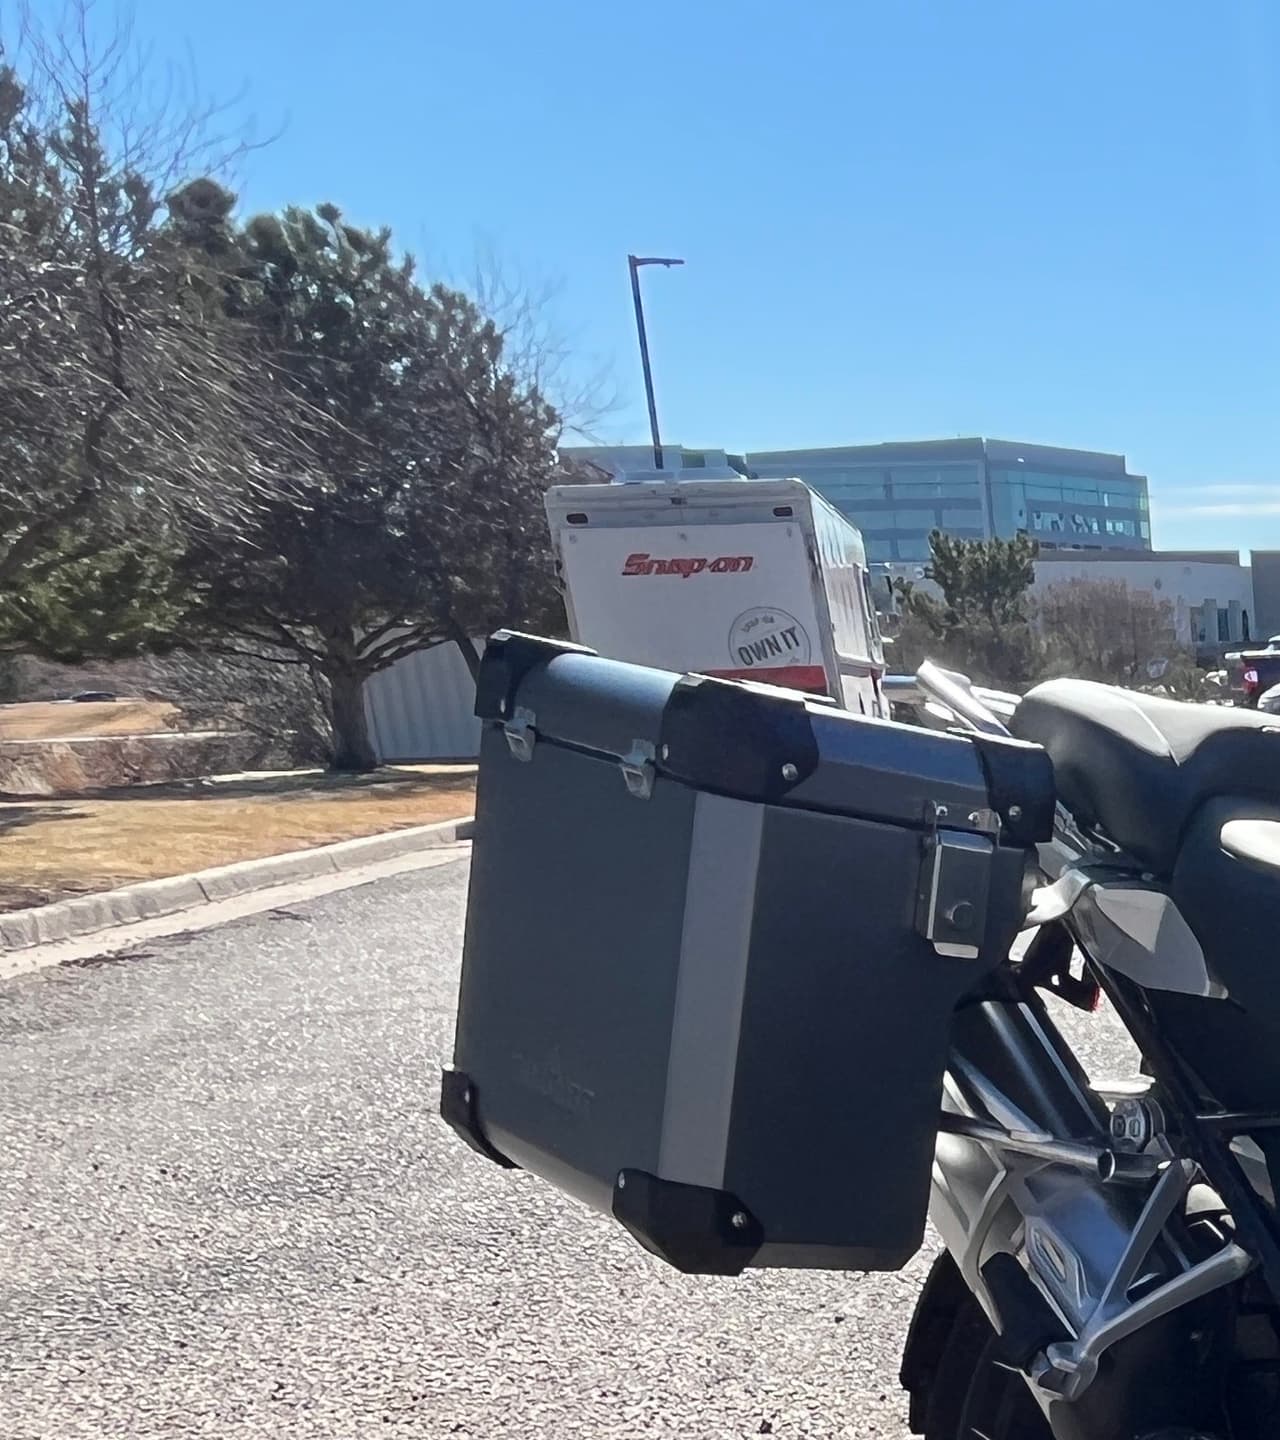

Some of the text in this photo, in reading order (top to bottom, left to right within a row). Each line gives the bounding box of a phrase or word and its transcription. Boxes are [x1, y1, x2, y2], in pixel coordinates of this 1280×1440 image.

[622, 553, 754, 579] Snap-on
[738, 626, 801, 666] OWN IT
